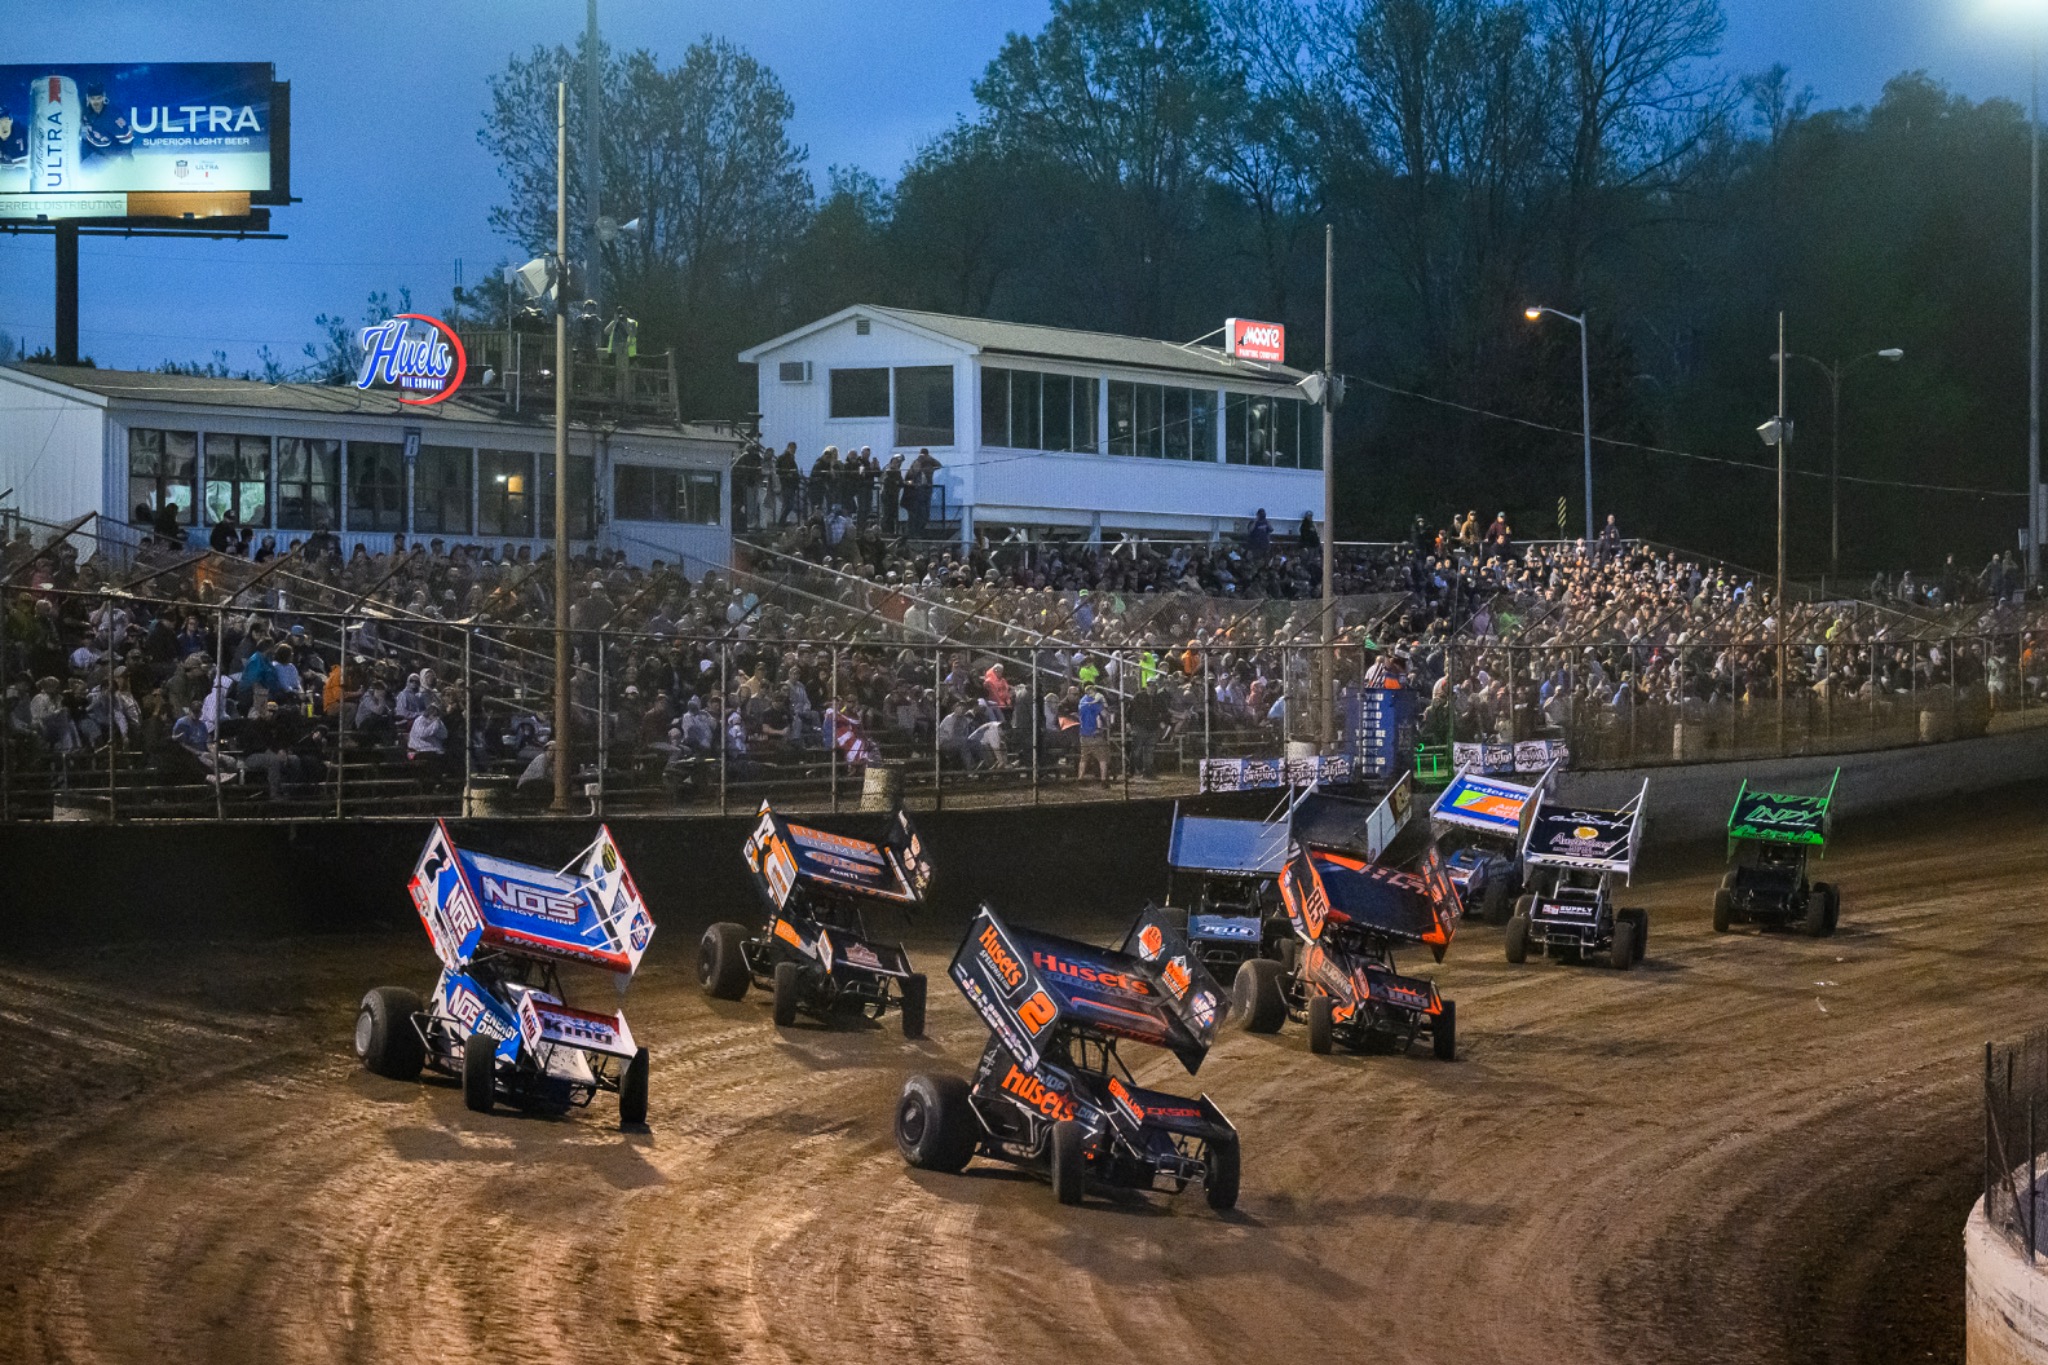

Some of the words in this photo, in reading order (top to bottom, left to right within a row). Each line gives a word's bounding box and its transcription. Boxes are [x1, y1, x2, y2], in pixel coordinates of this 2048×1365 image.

[131, 105, 261, 133] ULTRA
[47, 111, 62, 187] ULTRA
[143, 137, 192, 146] SUPERIOR
[193, 137, 223, 146] LIGHT
[224, 137, 250, 146] BEER
[44, 200, 122, 211] DISTRIBUTING
[1243, 326, 1280, 348] Moore
[357, 320, 452, 389] Huels
[401, 376, 413, 388] OIL
[414, 378, 443, 389] COMPANY
[1744, 805, 1823, 822] INDY
[444, 878, 479, 946] NOS
[480, 875, 588, 923] NOS
[484, 901, 535, 919] ENERGY
[537, 913, 578, 927] DRINK
[1560, 905, 1593, 913] SUPPLY
[979, 924, 1023, 987] Husets
[1032, 950, 1150, 995] Husets
[447, 983, 486, 1030] NOS
[1018, 991, 1057, 1035] 2
[481, 1009, 519, 1042] ENERGY
